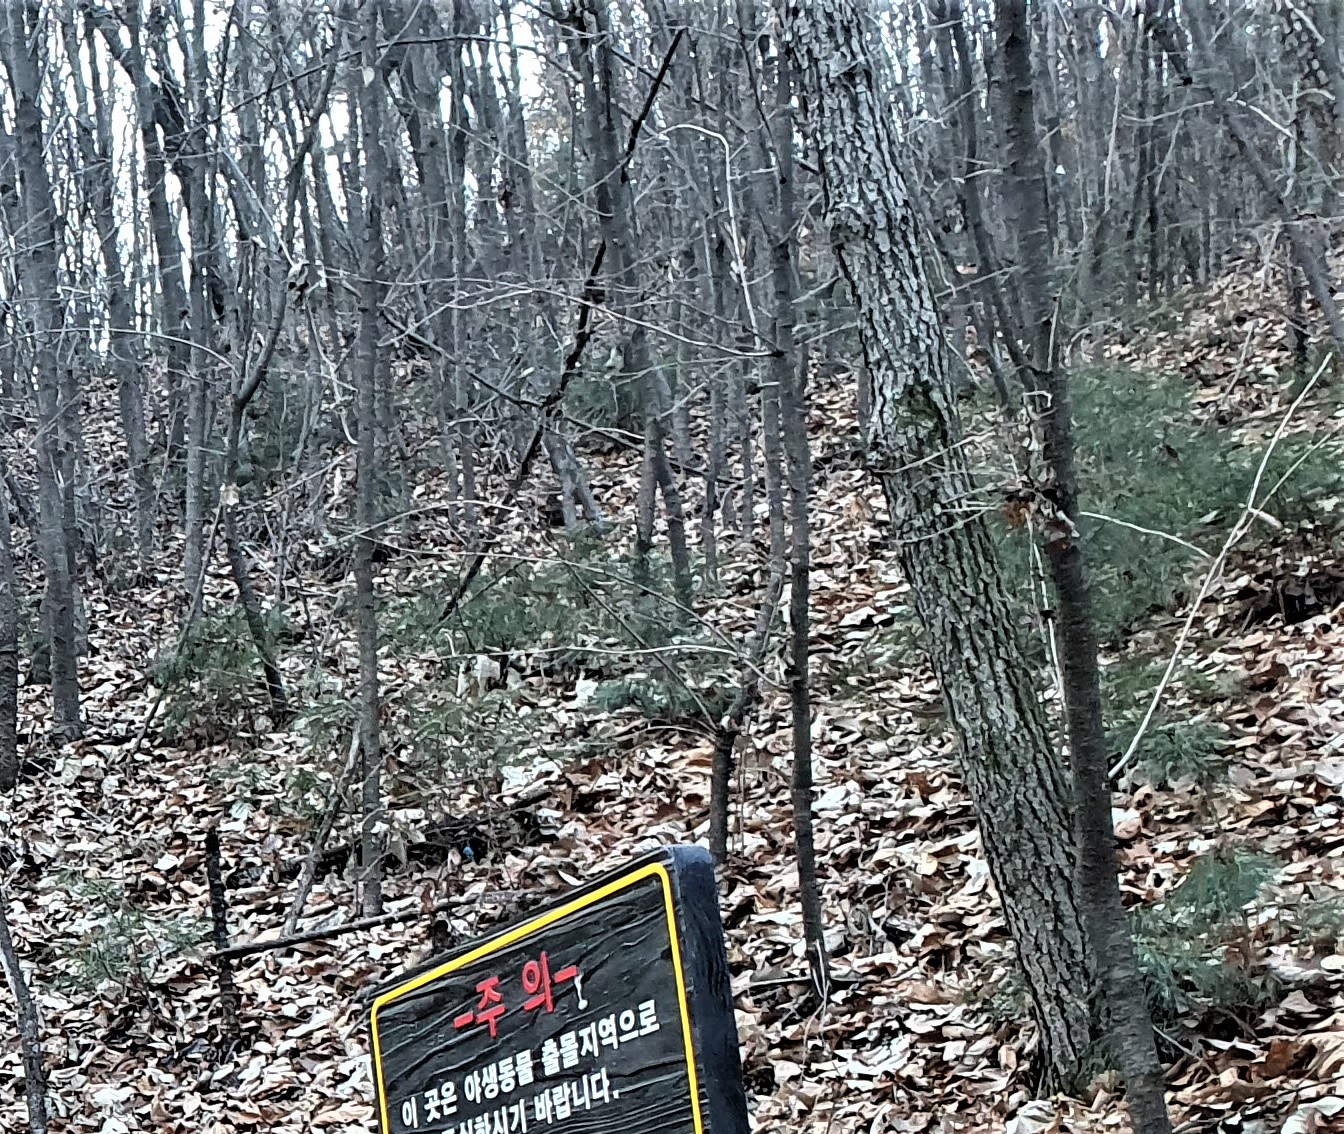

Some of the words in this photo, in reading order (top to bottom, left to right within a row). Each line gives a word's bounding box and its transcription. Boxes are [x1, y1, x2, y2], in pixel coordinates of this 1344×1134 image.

[401, 1097, 419, 1129] 이
[423, 1081, 458, 1122] 곳은
[464, 1049, 533, 1103] 야생동물
[541, 1000, 660, 1076] 출몰지역으로
[534, 1067, 619, 1124] 바랍니다.
